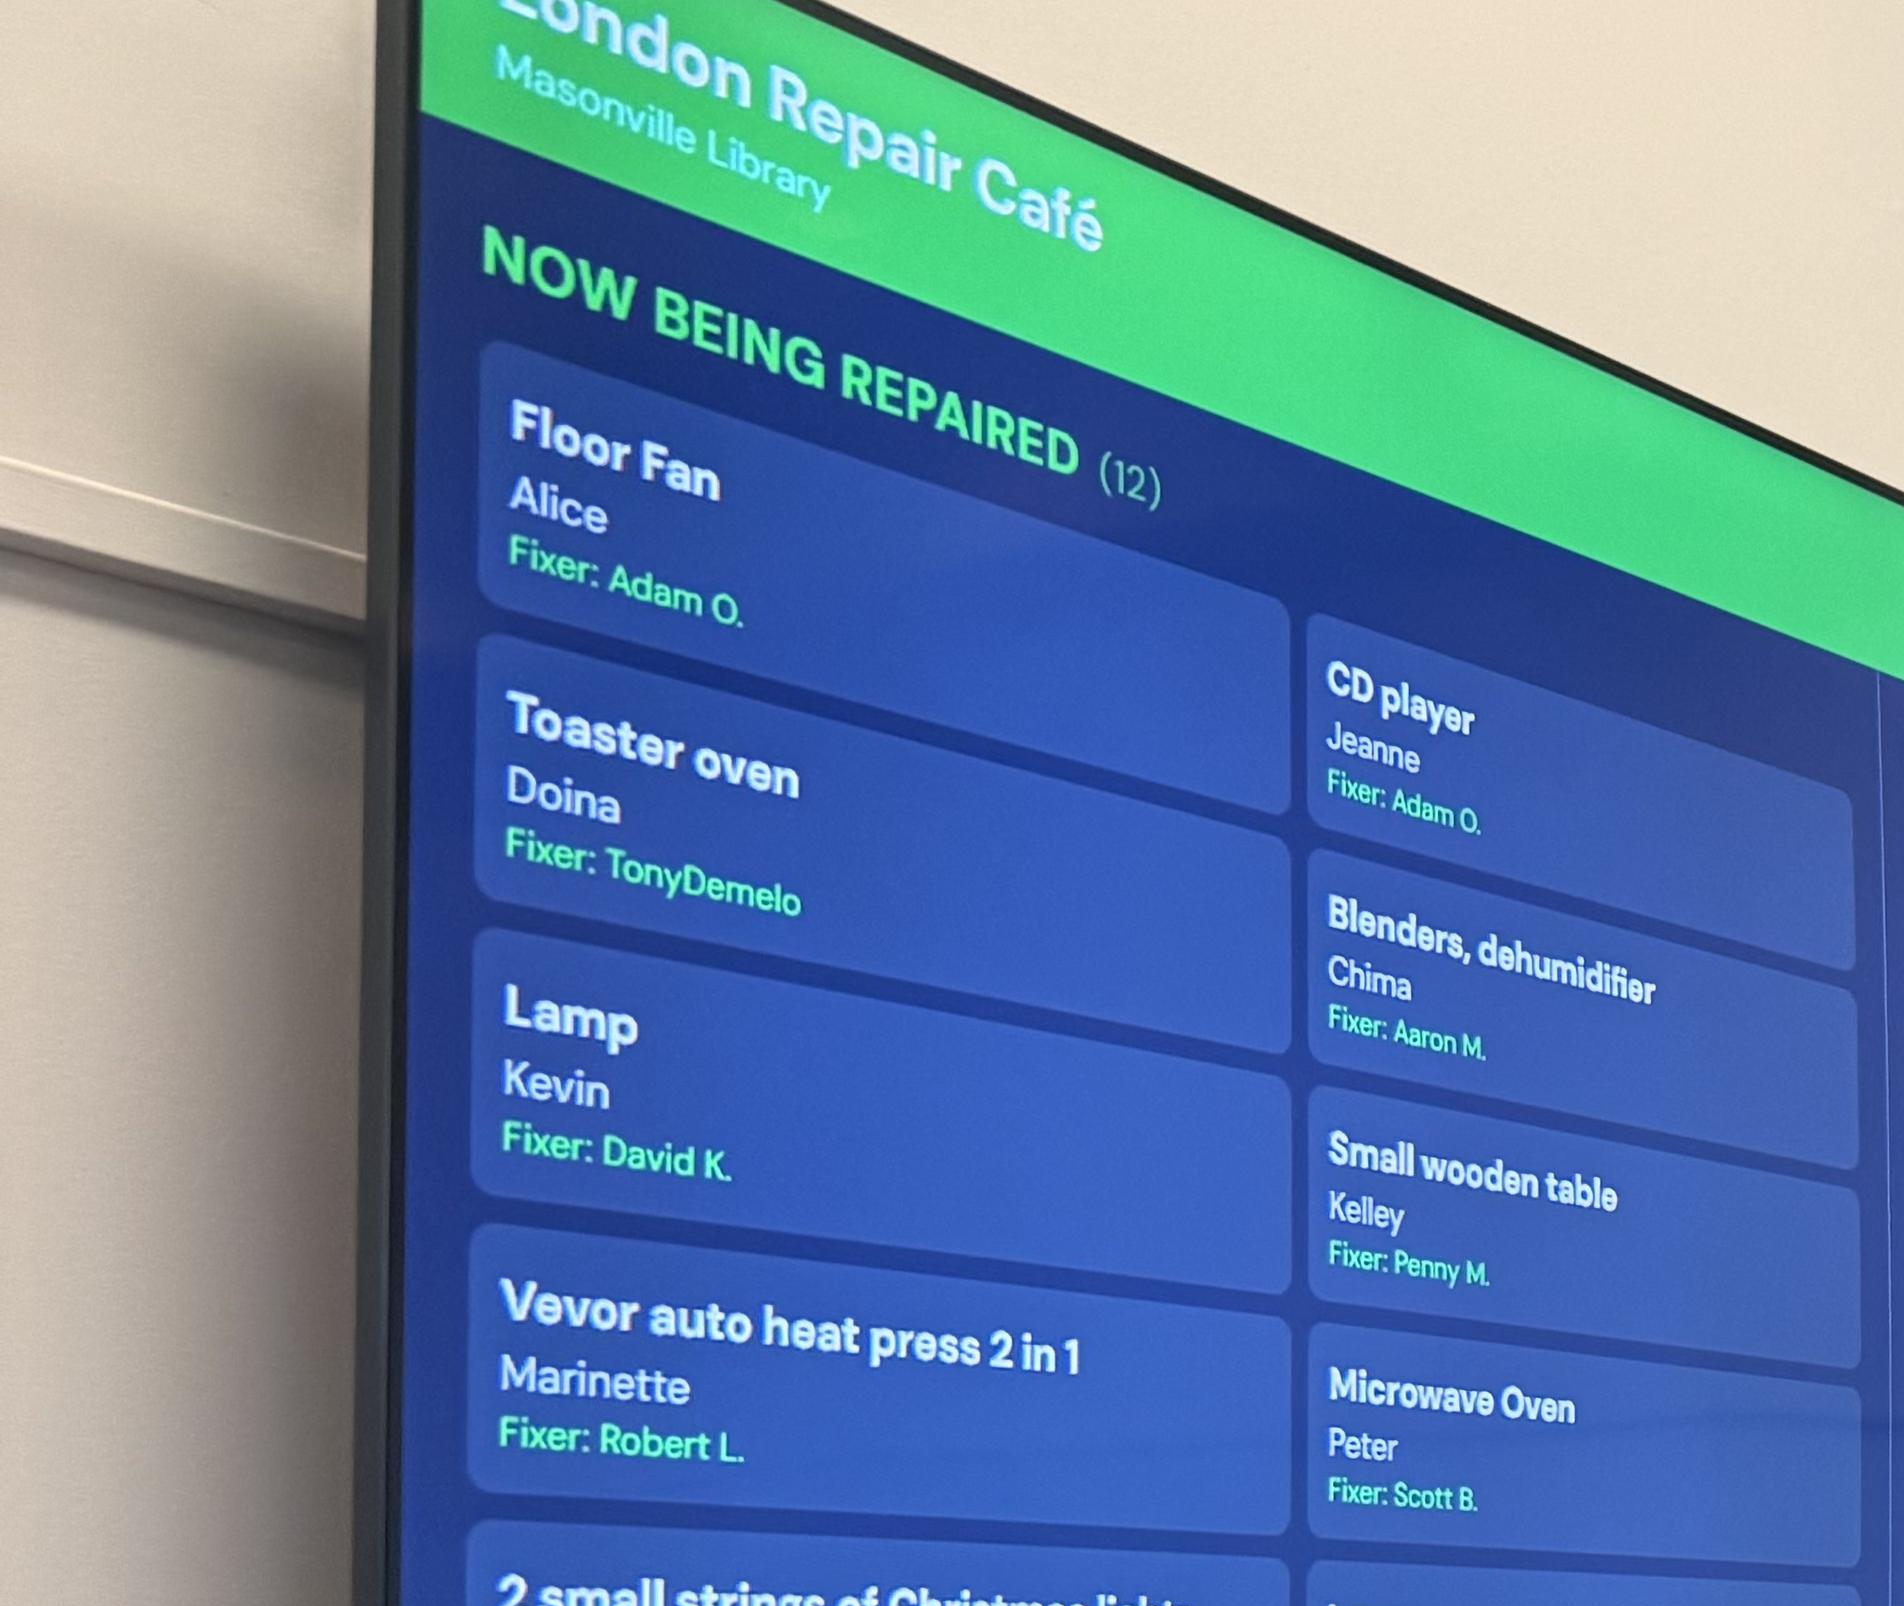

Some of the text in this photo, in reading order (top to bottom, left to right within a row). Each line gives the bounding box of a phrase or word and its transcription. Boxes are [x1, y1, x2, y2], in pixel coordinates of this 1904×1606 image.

[497, 44, 832, 215] Masonville Library
[772, 65, 963, 192] Repair
[977, 159, 1104, 253] Café
[483, 225, 1161, 512] NOW BEING REPAIRED (12)
[512, 399, 720, 502] Floor Fan
[509, 475, 608, 535] Alice
[1326, 660, 1476, 736] CD player
[506, 690, 799, 800] Toaster oven
[1325, 720, 1421, 774] Jeanne
[508, 764, 621, 825] Doina
[1327, 954, 1412, 1002] Chima
[1328, 894, 1657, 1006] Blenders, dehumidifier
[506, 983, 639, 1056] Lamp
[504, 1058, 610, 1111] Kevin
[1328, 1129, 1618, 1213] Small wooden table
[1328, 1190, 1406, 1238] Kelley
[500, 1278, 1079, 1376] Vevor auto heat press 2 in 1
[501, 1354, 691, 1406] Marinette
[1329, 1366, 1576, 1424] Microwave Oven
[1328, 1426, 1399, 1462] Peter
